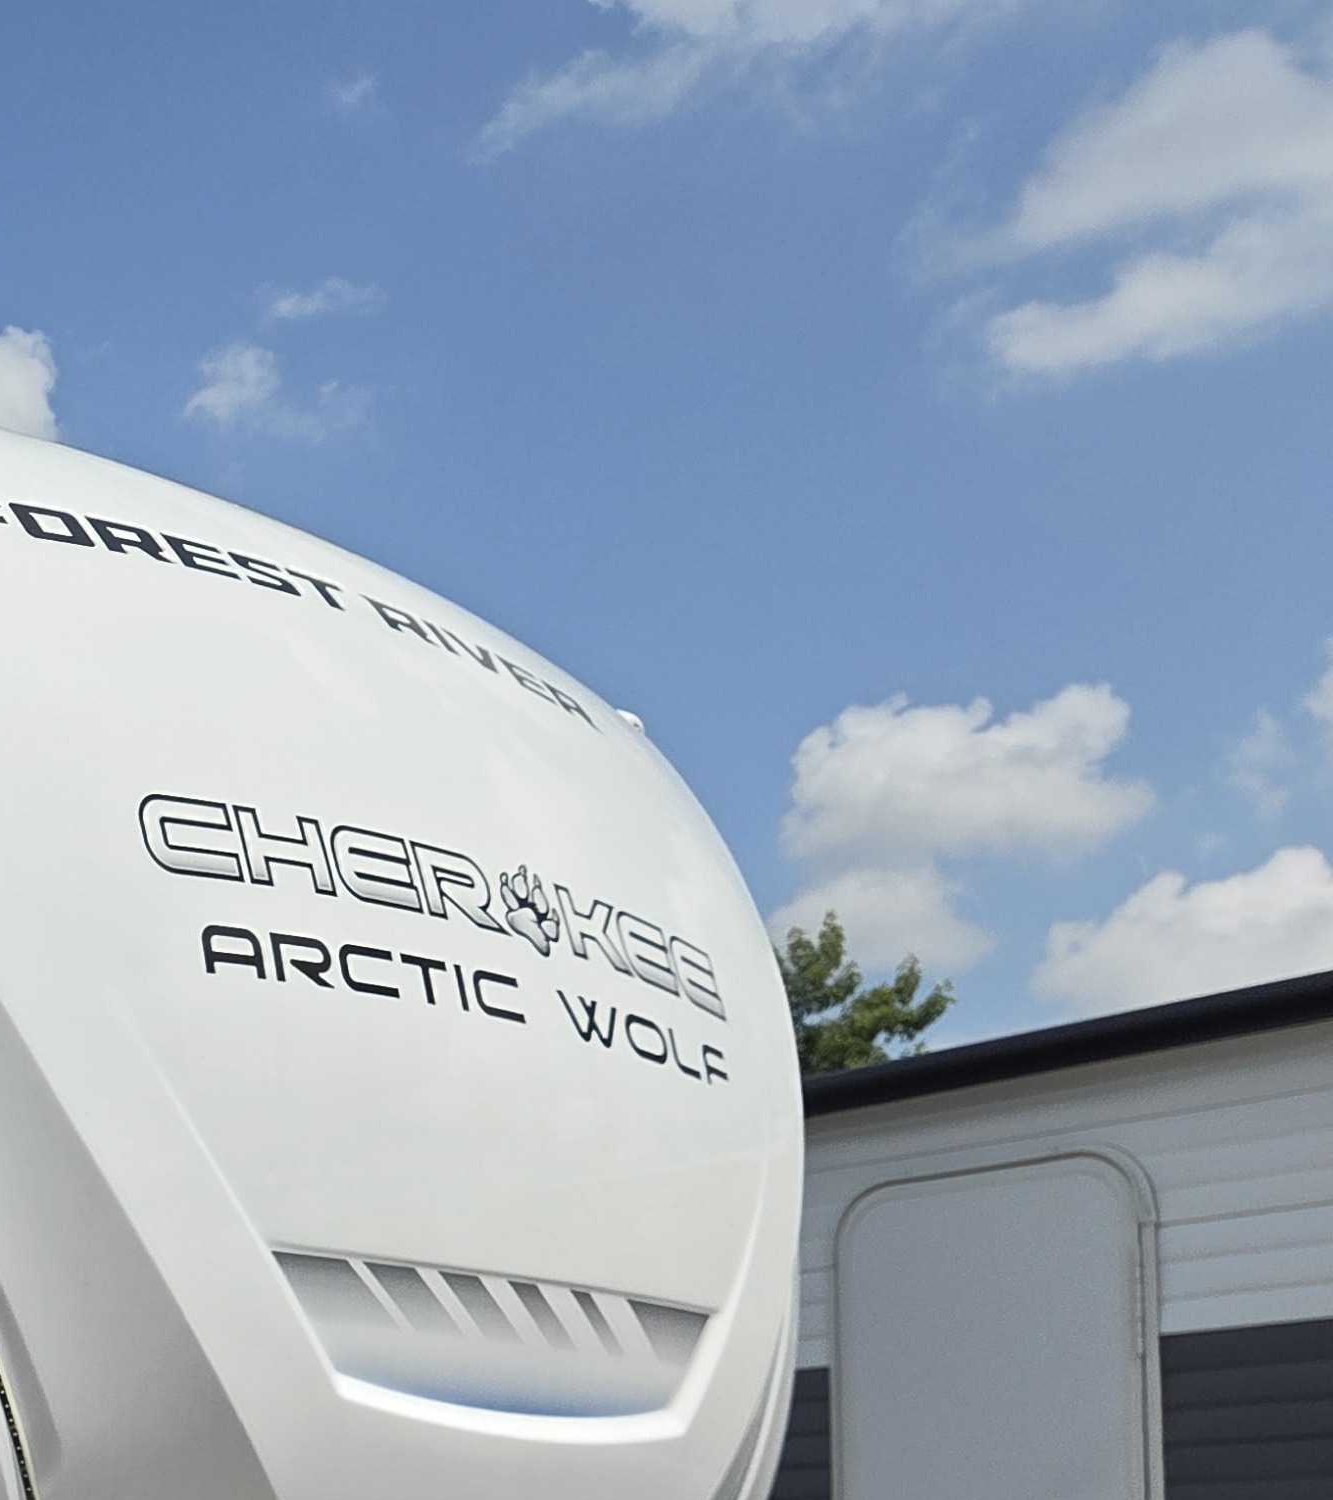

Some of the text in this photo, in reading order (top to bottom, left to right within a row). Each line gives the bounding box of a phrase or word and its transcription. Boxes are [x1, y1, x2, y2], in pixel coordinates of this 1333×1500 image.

[360, 593, 605, 734] RIVER
[200, 923, 730, 1086] ARCTIC WOLF
